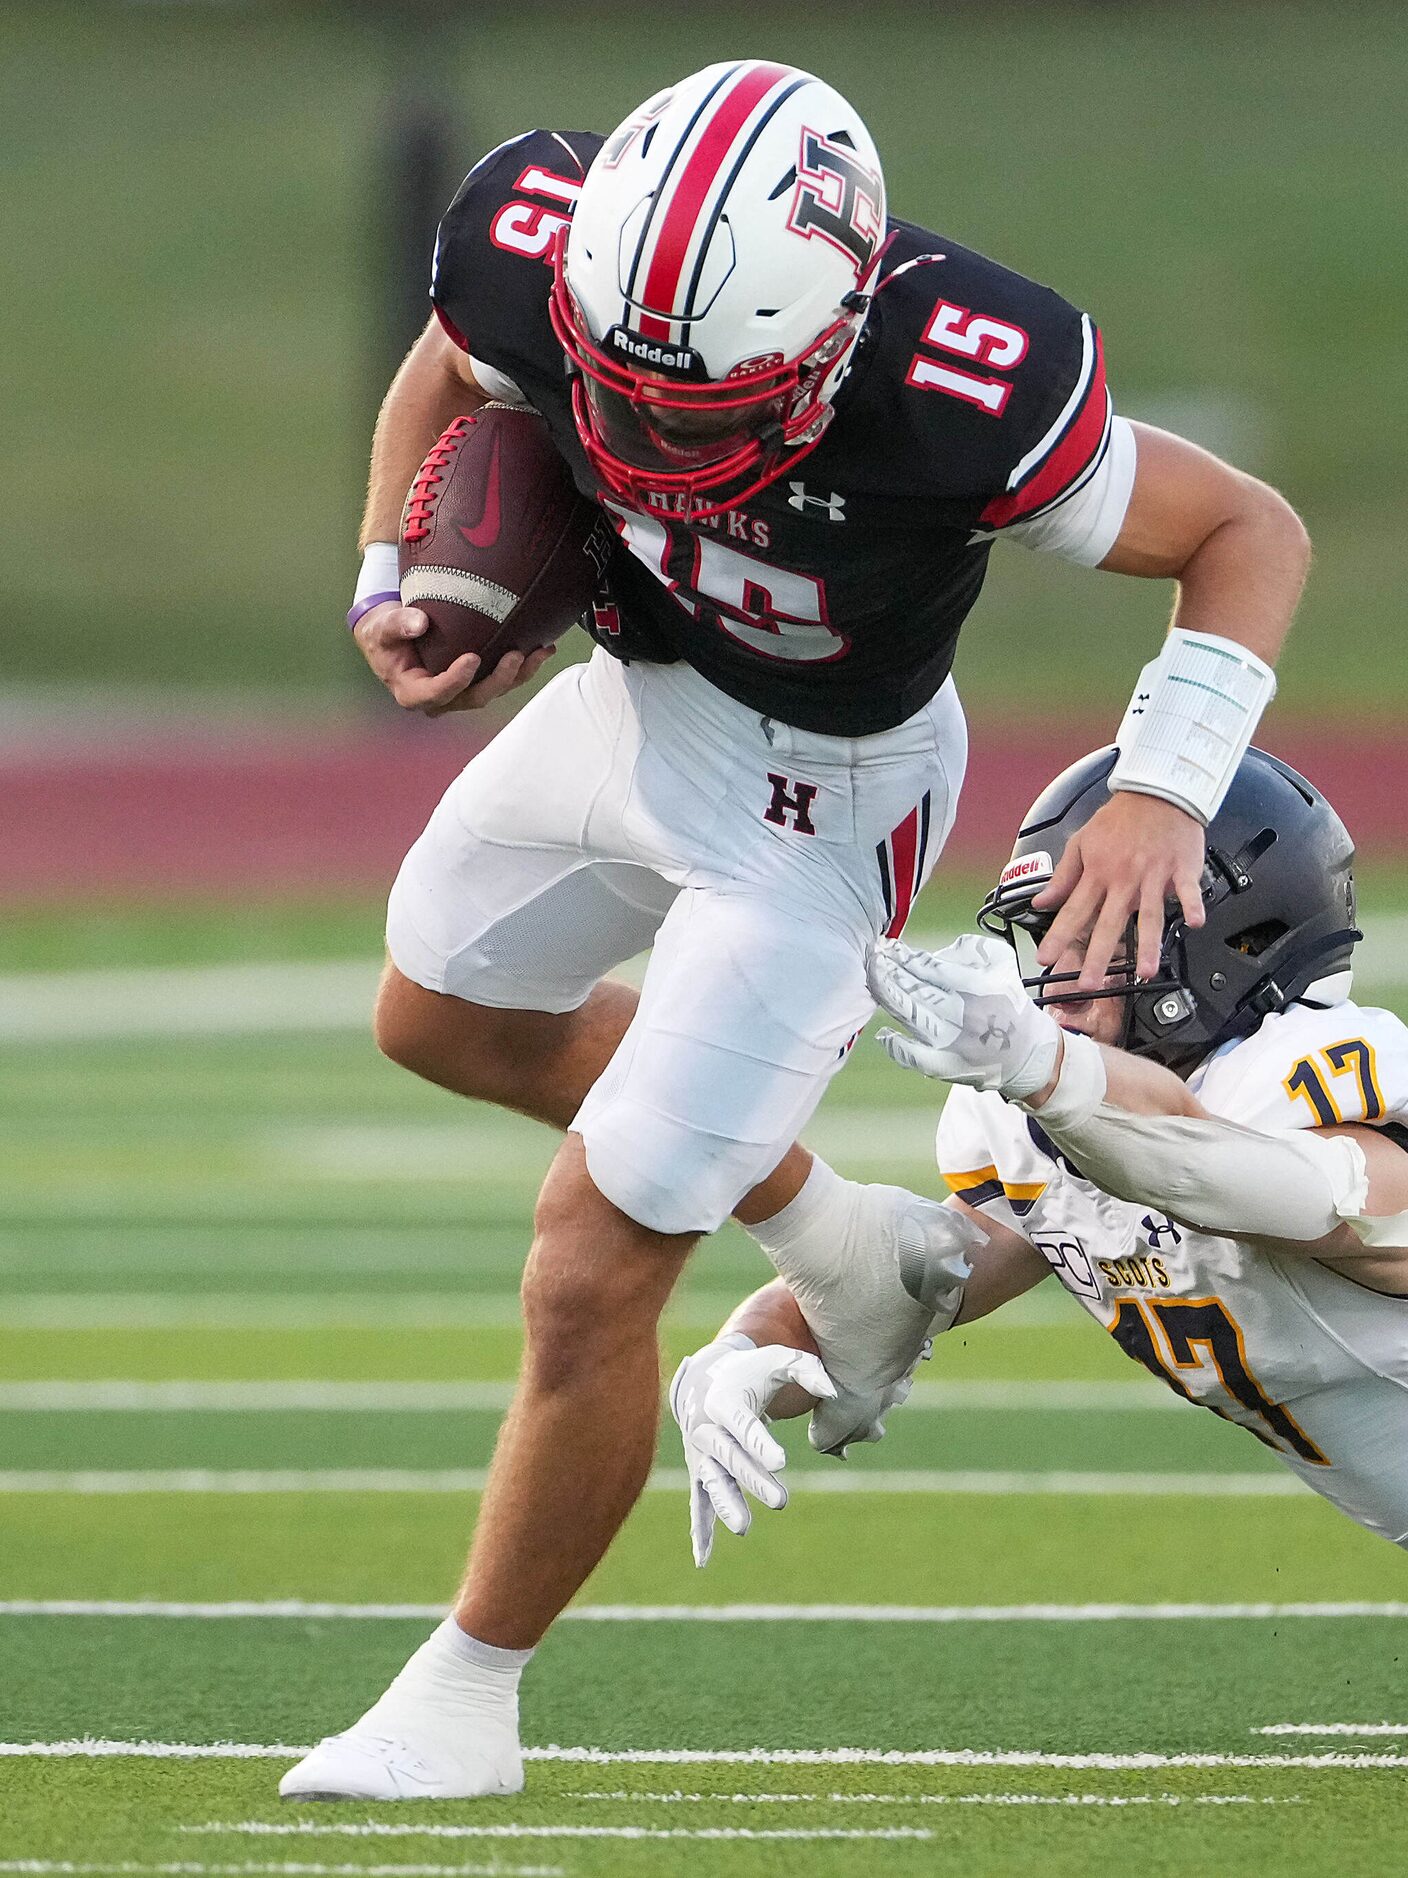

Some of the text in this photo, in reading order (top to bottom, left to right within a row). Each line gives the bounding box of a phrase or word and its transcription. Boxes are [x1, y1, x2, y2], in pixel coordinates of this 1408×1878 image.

[489, 164, 585, 267] 15
[612, 329, 691, 369] Riddell
[904, 297, 1030, 419] 15
[597, 490, 851, 664] 15
[763, 772, 819, 836] H
[1281, 1036, 1387, 1127] 17
[1098, 1256, 1171, 1289] SCOTS
[1106, 1295, 1333, 1467] 17
